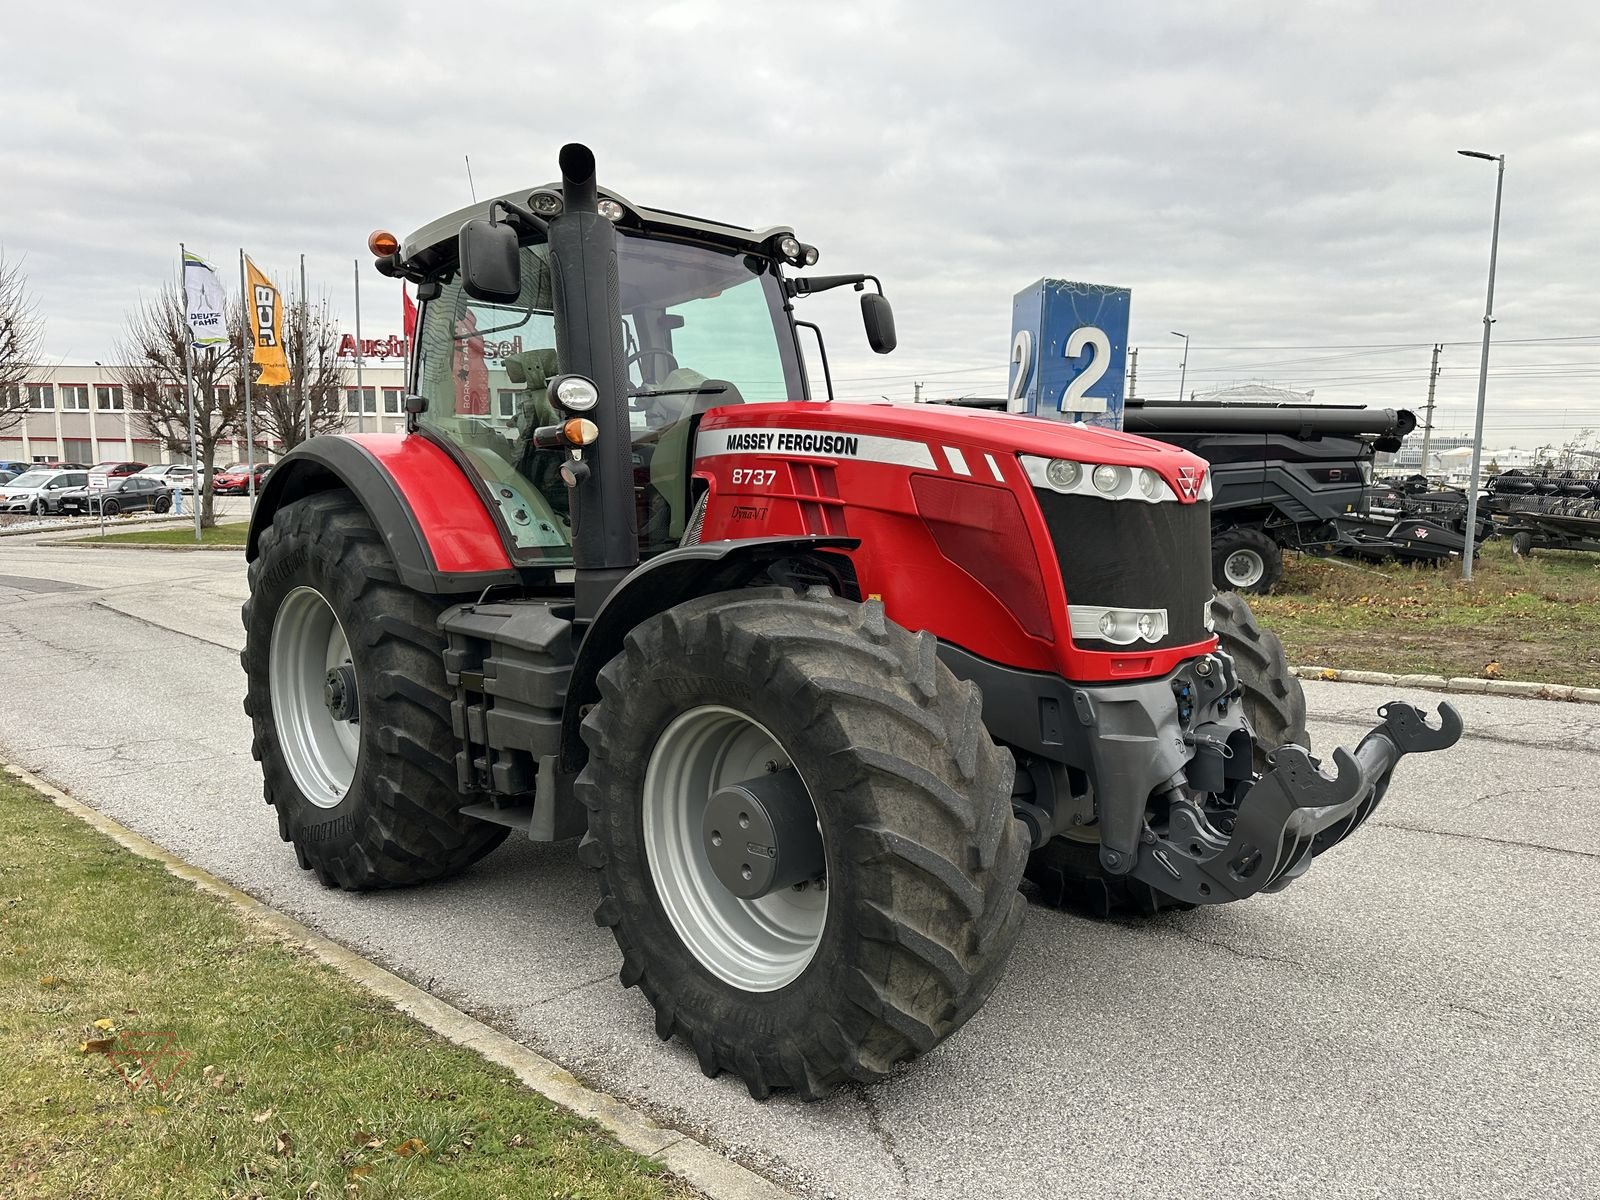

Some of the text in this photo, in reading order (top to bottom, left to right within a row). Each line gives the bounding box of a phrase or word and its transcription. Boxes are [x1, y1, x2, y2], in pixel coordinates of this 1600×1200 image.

[193, 317, 218, 326] FAHR
[255, 285, 276, 346] JCB
[337, 333, 410, 358] Austr
[1010, 330, 1031, 413] 2
[1061, 326, 1111, 413] 2
[463, 380, 471, 409] BORN
[726, 433, 858, 455] MASSEY FERGUSON
[732, 468, 777, 486] 8737
